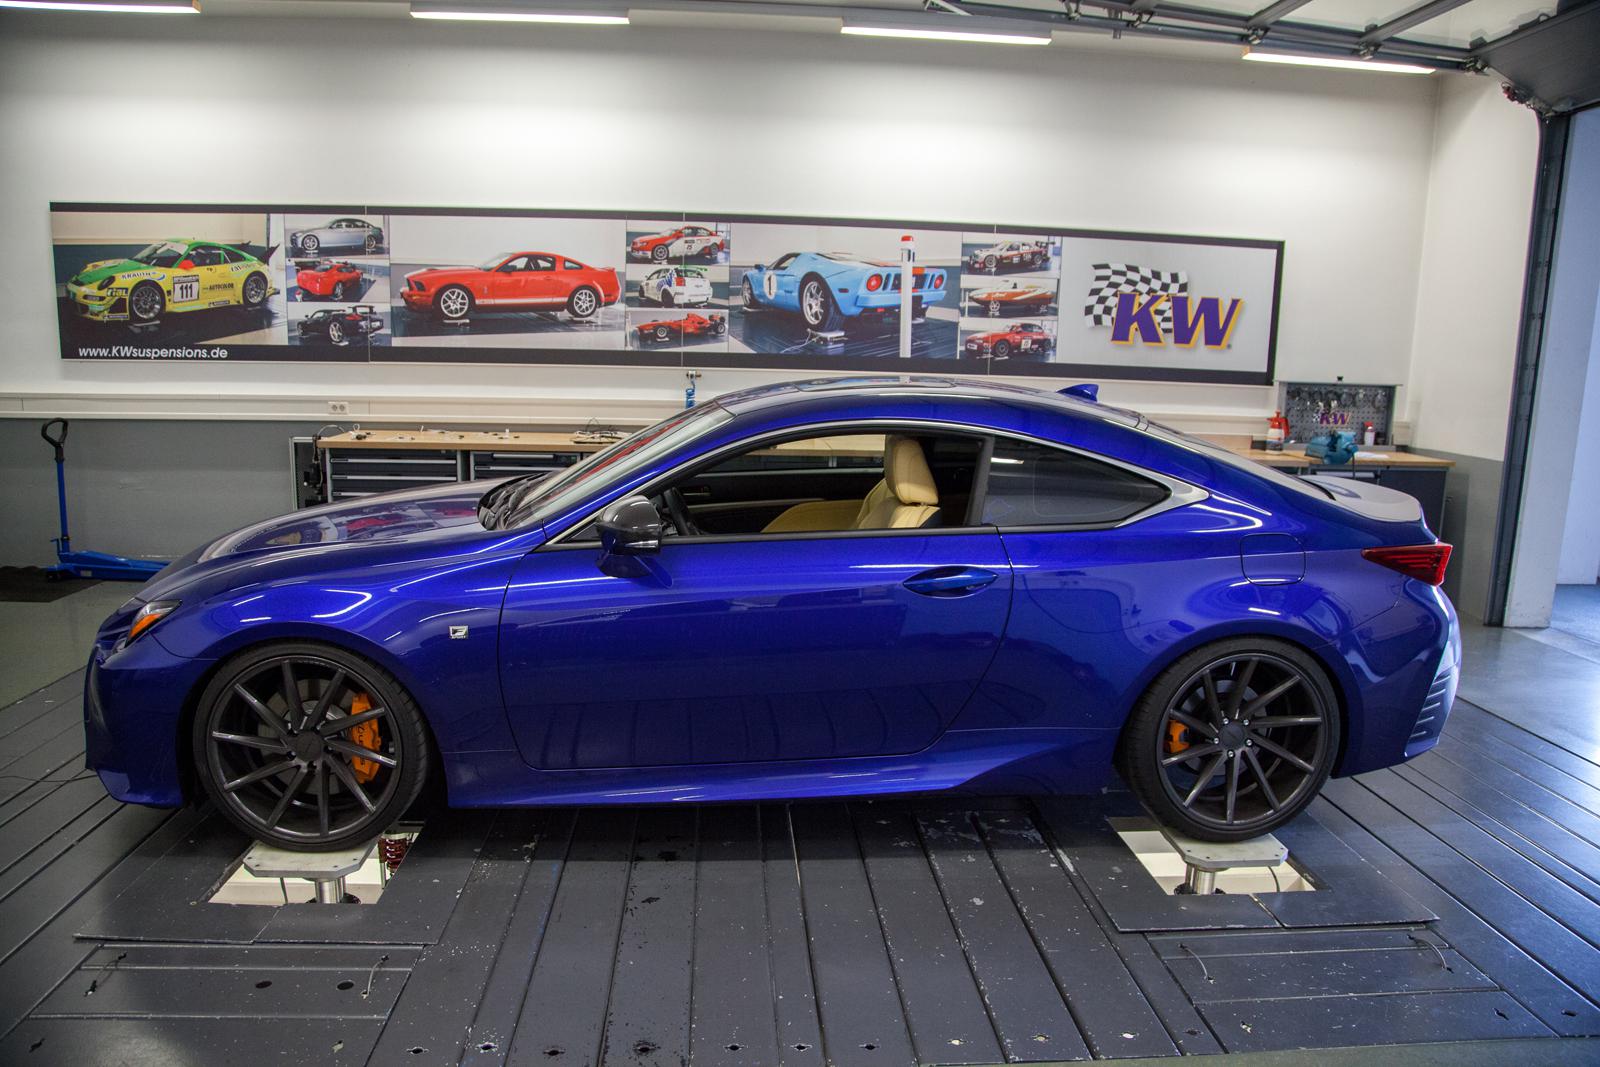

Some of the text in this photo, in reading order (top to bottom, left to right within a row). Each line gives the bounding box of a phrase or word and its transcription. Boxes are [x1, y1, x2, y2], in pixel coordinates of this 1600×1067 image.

[179, 283, 194, 299] 111
[1111, 291, 1244, 349] KW
[78, 346, 228, 360] www.KWsuspensions.de
[1319, 411, 1350, 425] KW
